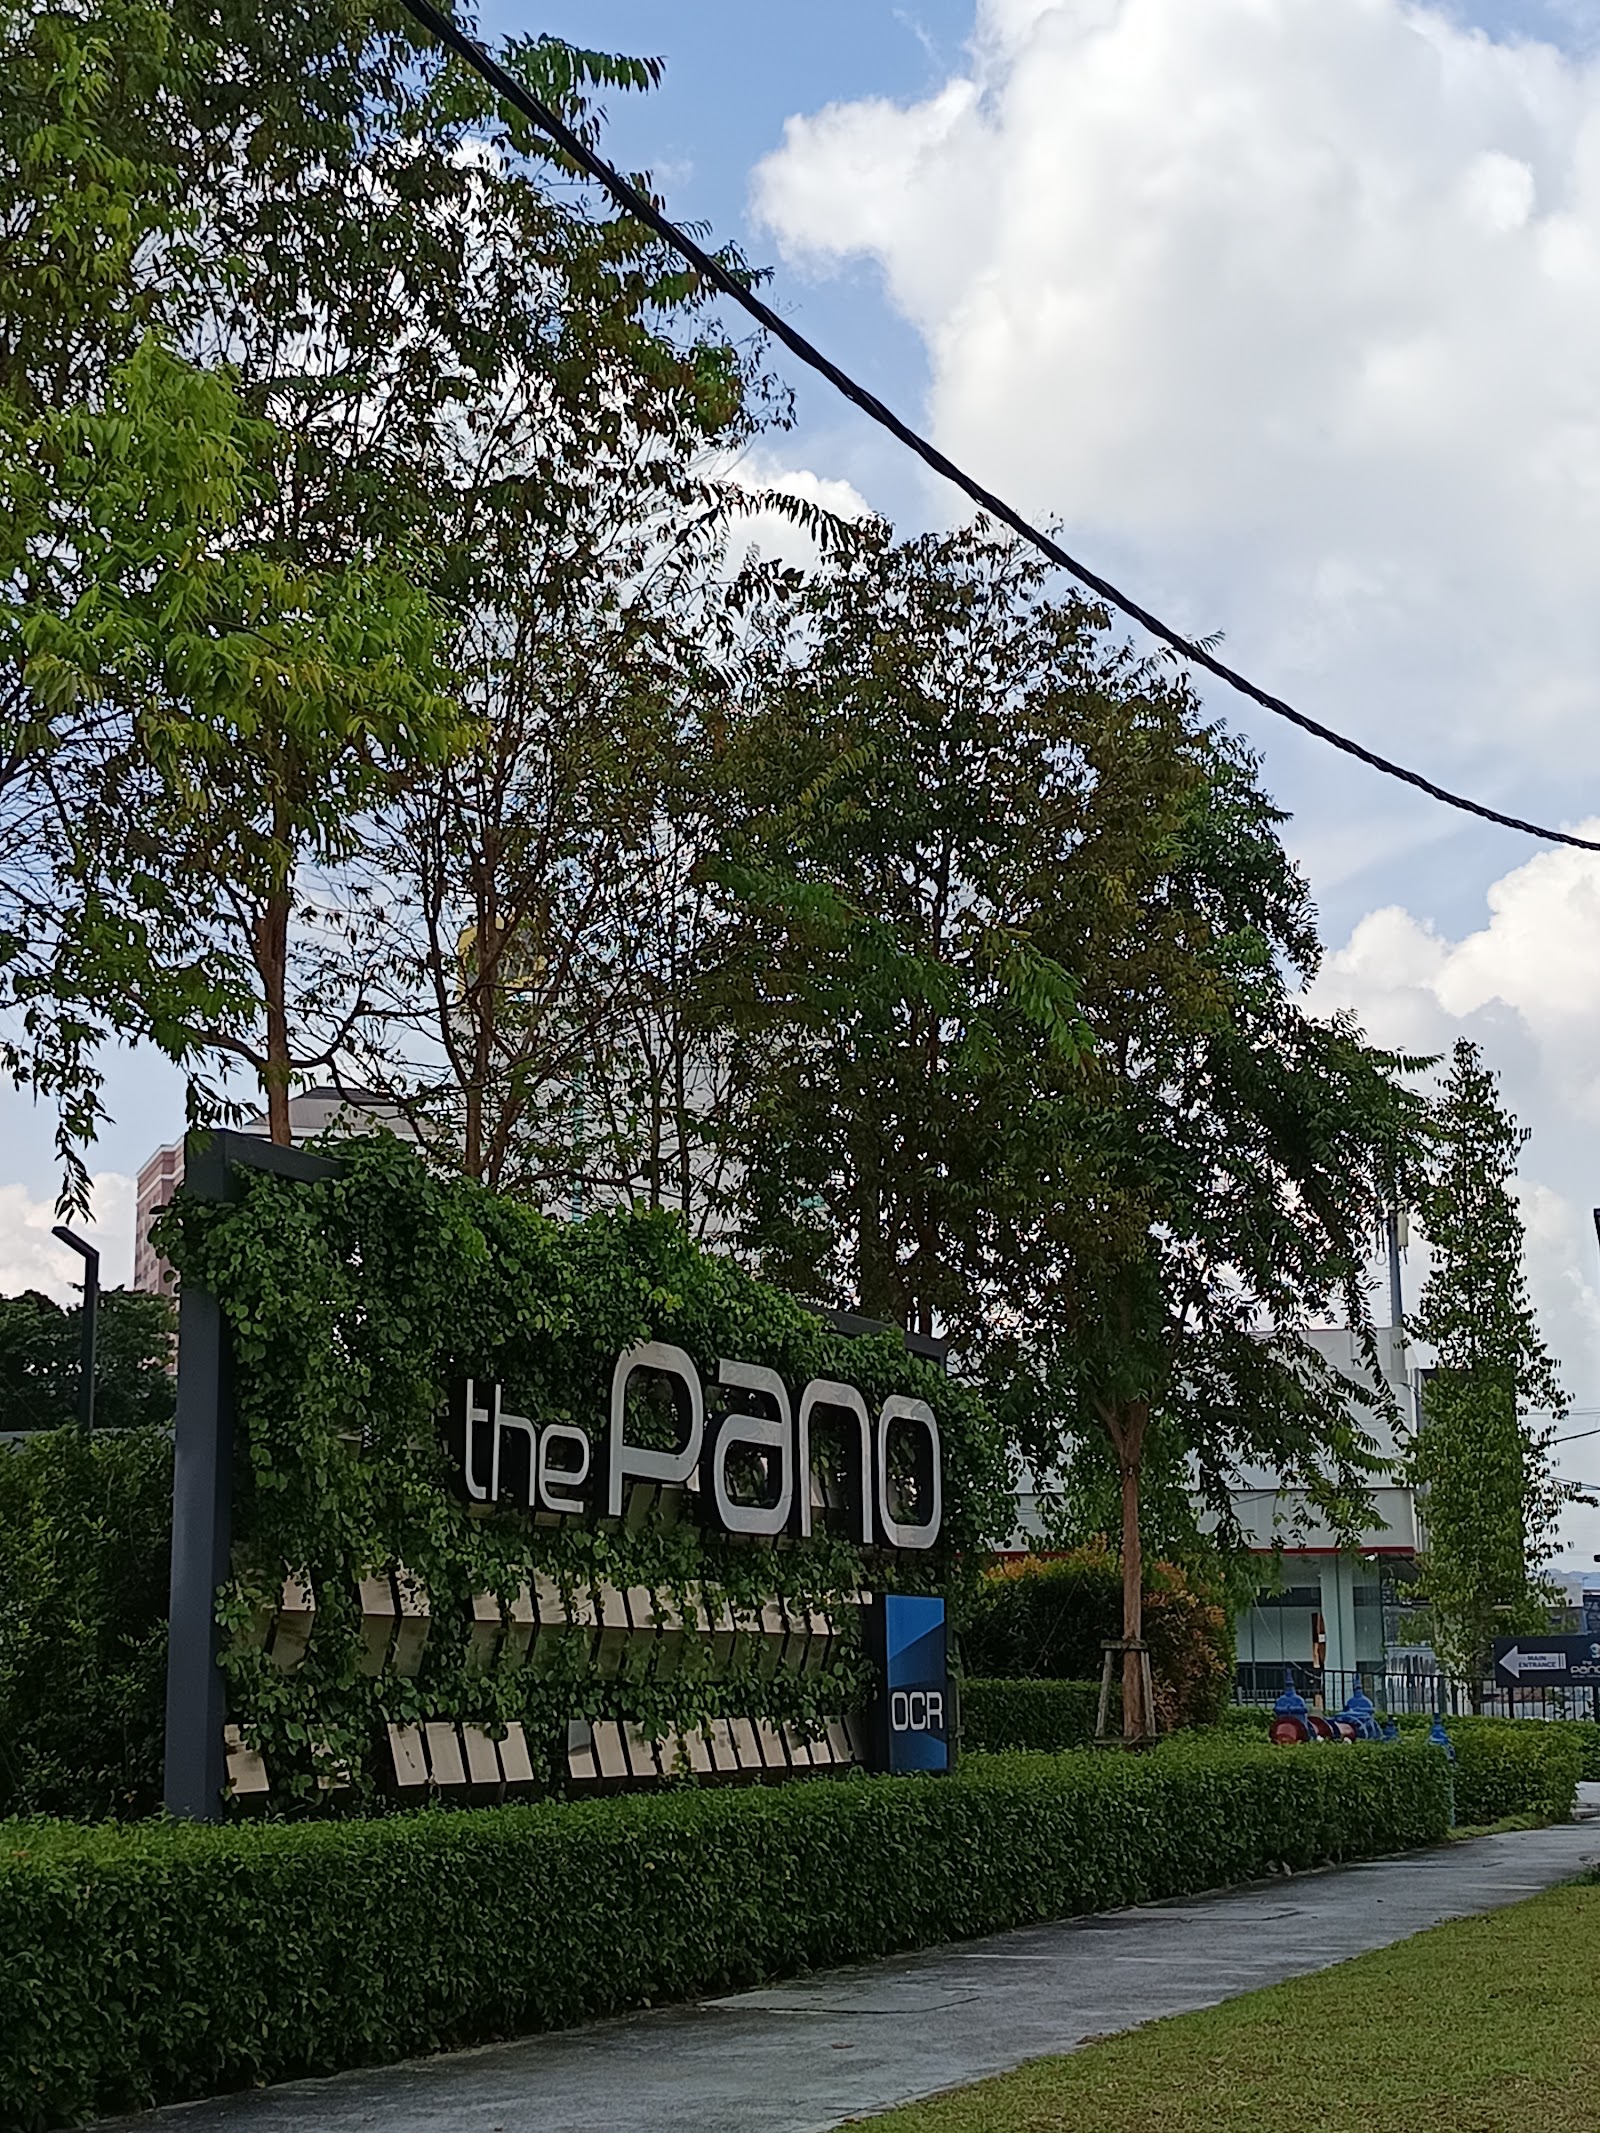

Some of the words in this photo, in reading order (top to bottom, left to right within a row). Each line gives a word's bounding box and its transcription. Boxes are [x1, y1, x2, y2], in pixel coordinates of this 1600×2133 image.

[466, 1378, 590, 1514] the
[610, 1341, 942, 1549] Pano
[891, 1691, 943, 1731] OCR
